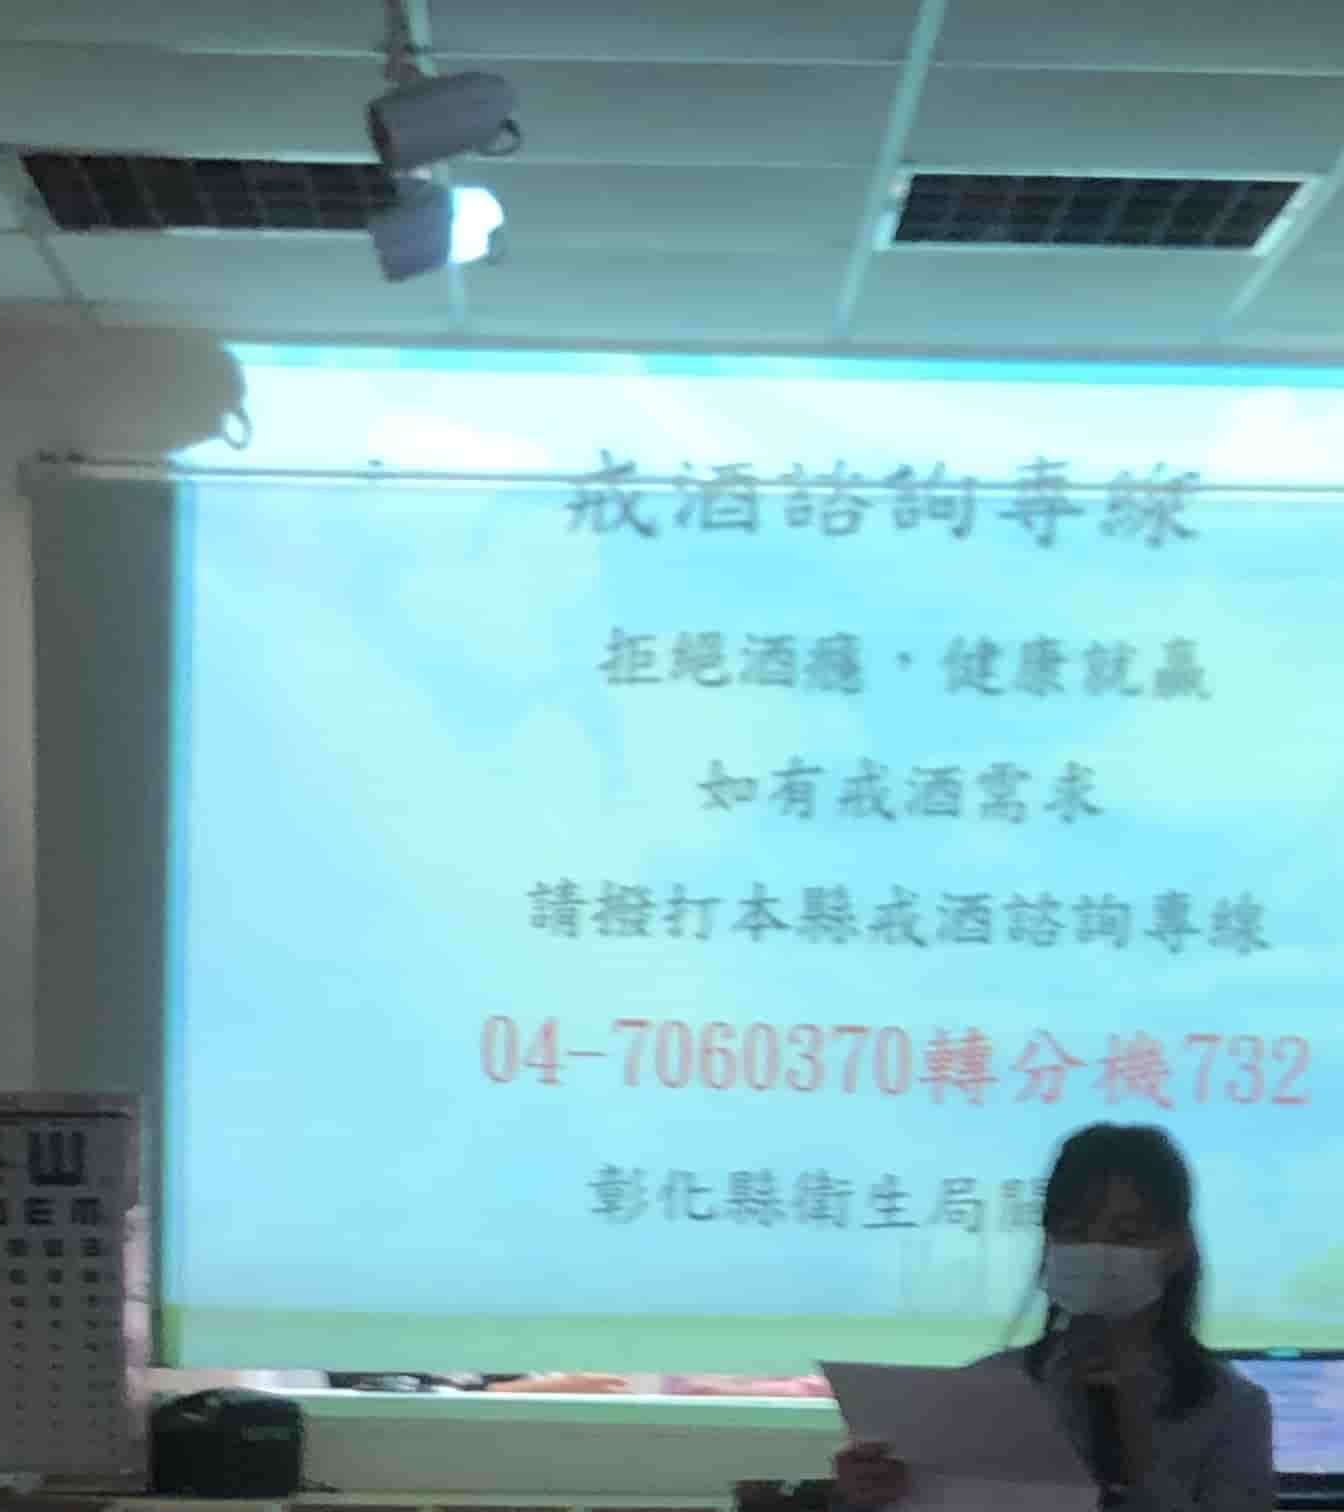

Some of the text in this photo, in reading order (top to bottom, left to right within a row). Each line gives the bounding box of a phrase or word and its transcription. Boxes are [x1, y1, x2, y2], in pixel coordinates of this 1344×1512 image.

[565, 449, 1204, 550] 戒酒諮詢專線
[696, 757, 1105, 825] 如有戒酒需求
[526, 877, 1272, 955] 請撥打本縣戒酒諮詢專線
[480, 1014, 1313, 1110] 04-7060370轉分機732
